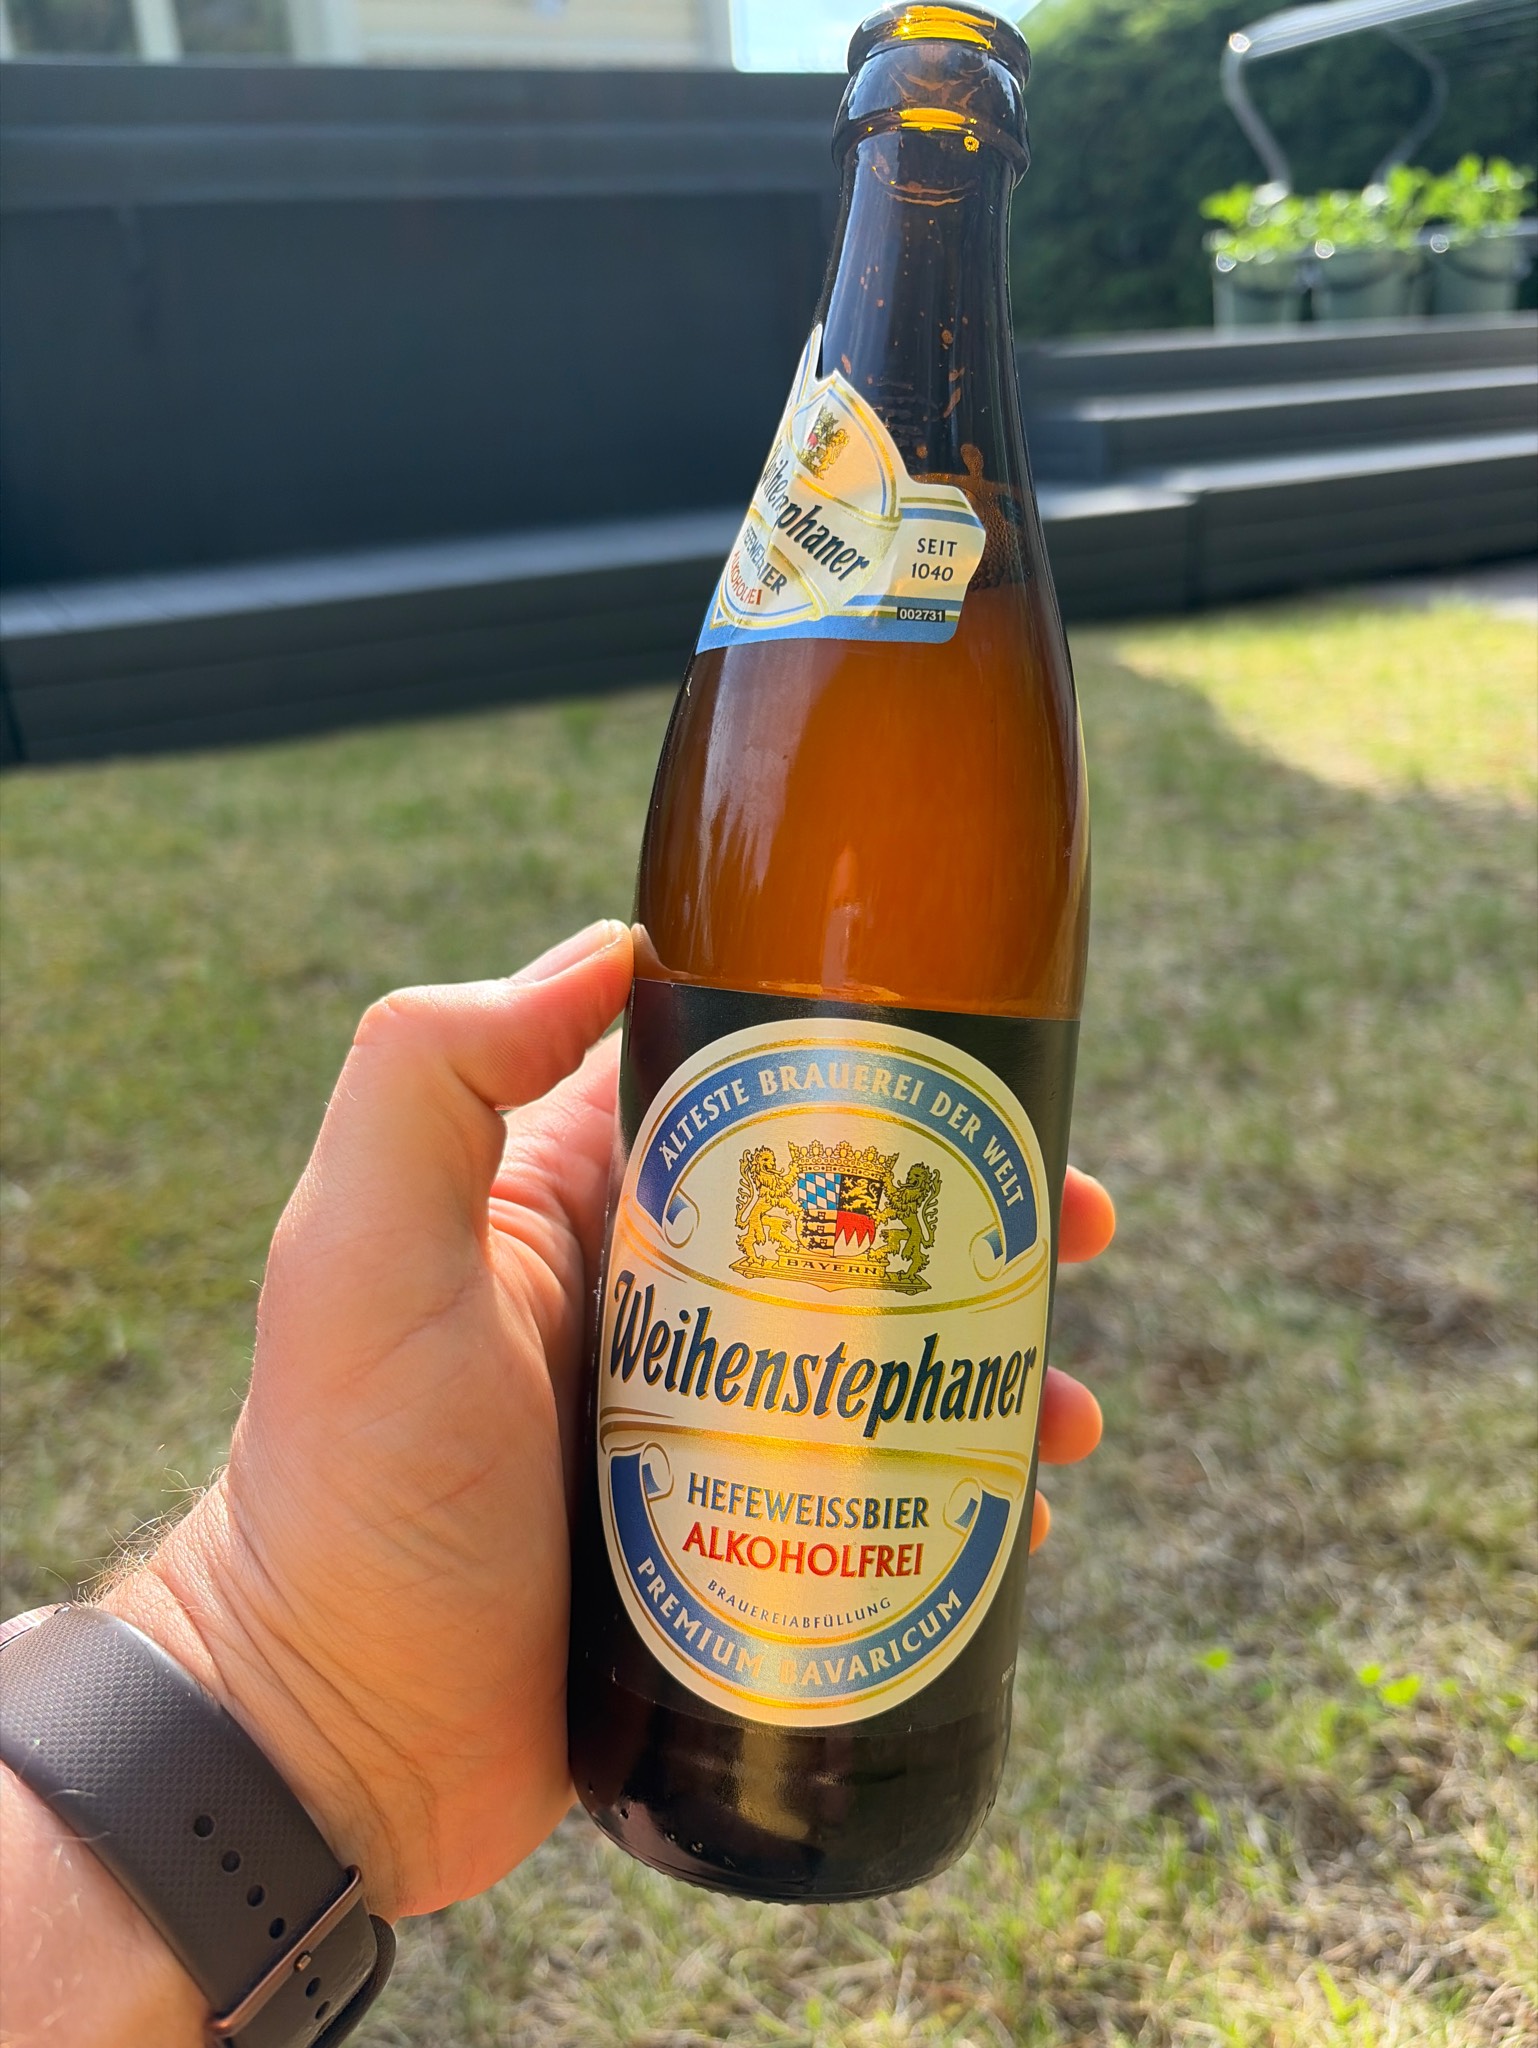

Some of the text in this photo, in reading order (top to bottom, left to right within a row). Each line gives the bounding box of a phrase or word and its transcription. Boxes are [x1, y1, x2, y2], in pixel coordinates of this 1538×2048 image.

[910, 561, 955, 582] 1040
[916, 537, 959, 557] SEIT
[899, 609, 945, 622] 002731
[658, 1061, 1025, 1208] ÄLTESTE BRAUEREI DER WELT
[786, 1258, 878, 1276] BAYERN
[609, 1269, 1038, 1439] Weihenstephaner
[687, 1472, 930, 1530] HEFEWEISSBIER
[681, 1521, 925, 1578] ALKOHOLFREI
[637, 1556, 963, 1686] PREMIUM BAVARICUM
[707, 1579, 892, 1629] BRAUEREIABFÜLLUNG
